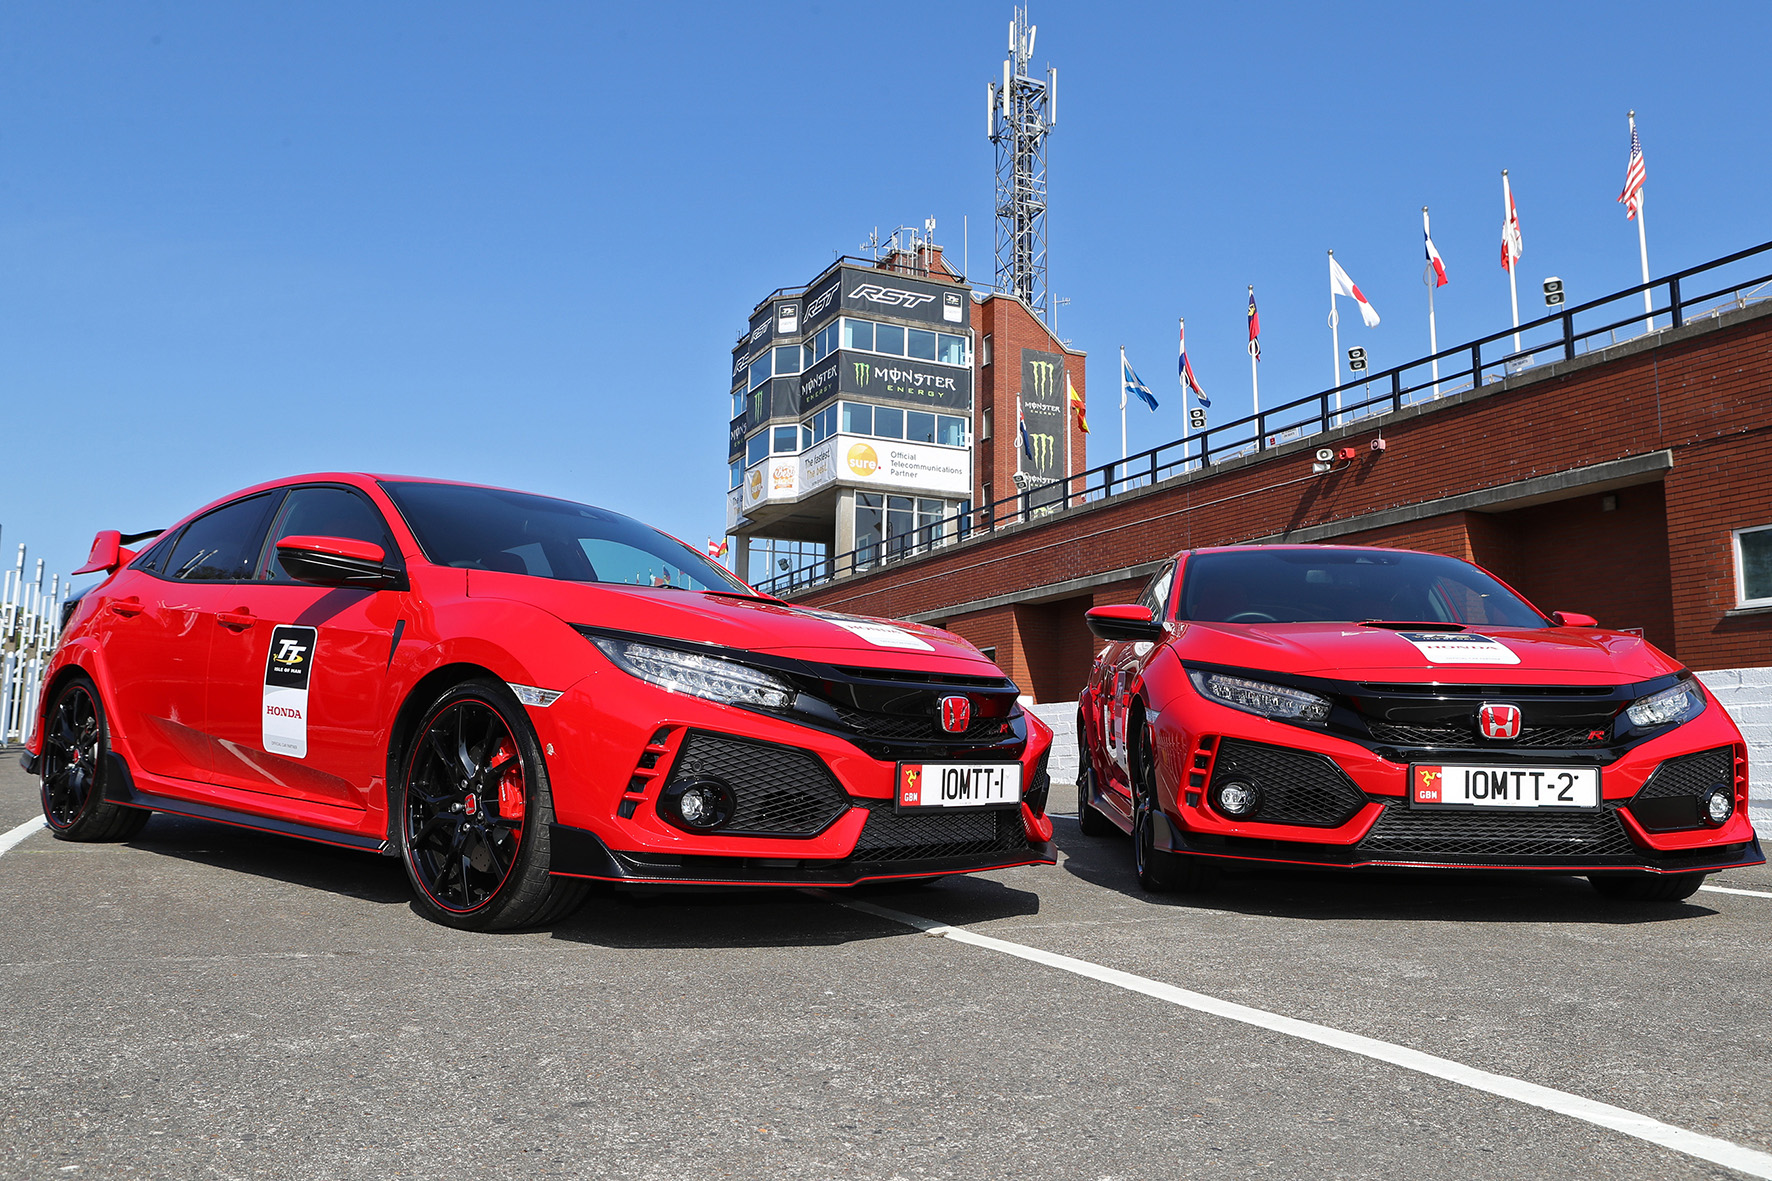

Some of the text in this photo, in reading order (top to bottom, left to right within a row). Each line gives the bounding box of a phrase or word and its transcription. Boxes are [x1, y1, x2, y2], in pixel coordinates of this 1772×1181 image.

[802, 281, 841, 324] RST
[848, 283, 936, 309] RST
[887, 384, 945, 398] ENERGY
[890, 451, 917, 461] Official
[890, 460, 963, 475] Telecommunications
[890, 468, 919, 479] Partner
[266, 705, 302, 719] HONDA
[1587, 730, 1605, 740] R
